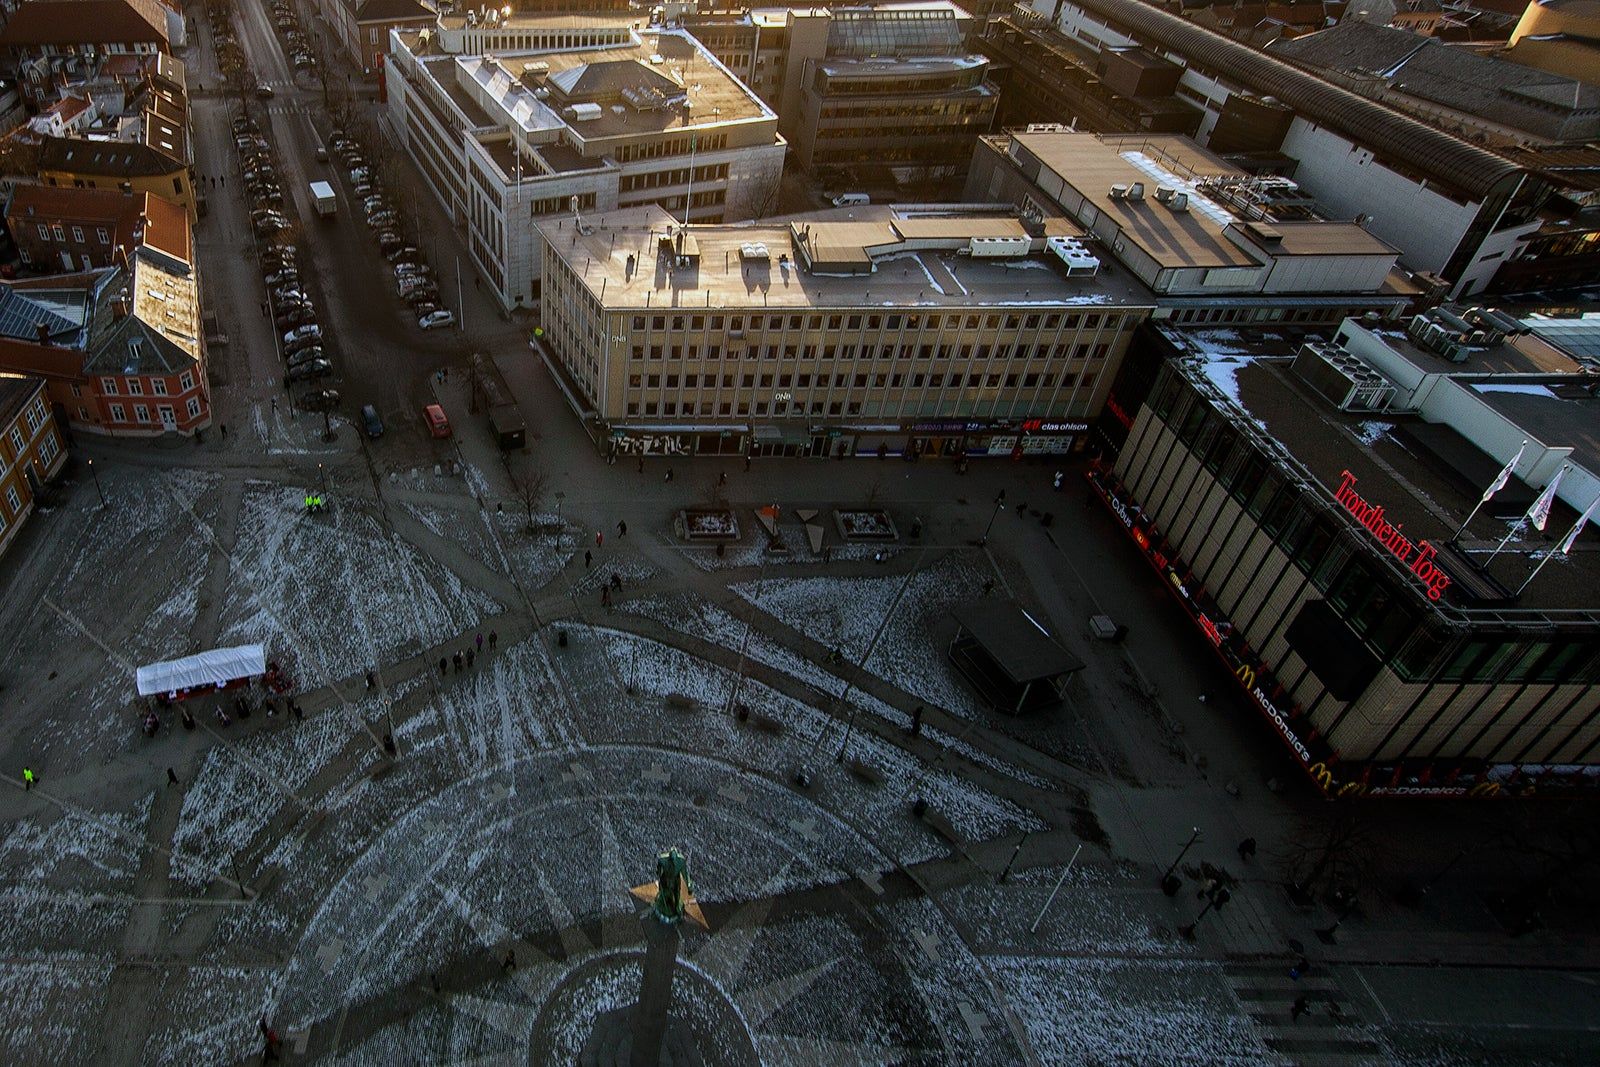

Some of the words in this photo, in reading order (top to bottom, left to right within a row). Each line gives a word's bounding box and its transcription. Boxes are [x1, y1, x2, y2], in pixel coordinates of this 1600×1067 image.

[1041, 423, 1061, 431] clas
[1060, 422, 1088, 431] ohlson
[1112, 497, 1133, 528] Cubus
[1335, 469, 1412, 560] Trondheim
[1410, 540, 1452, 601] Torg
[1253, 683, 1311, 762] McDonald's
[1370, 785, 1468, 796] McDonald's
